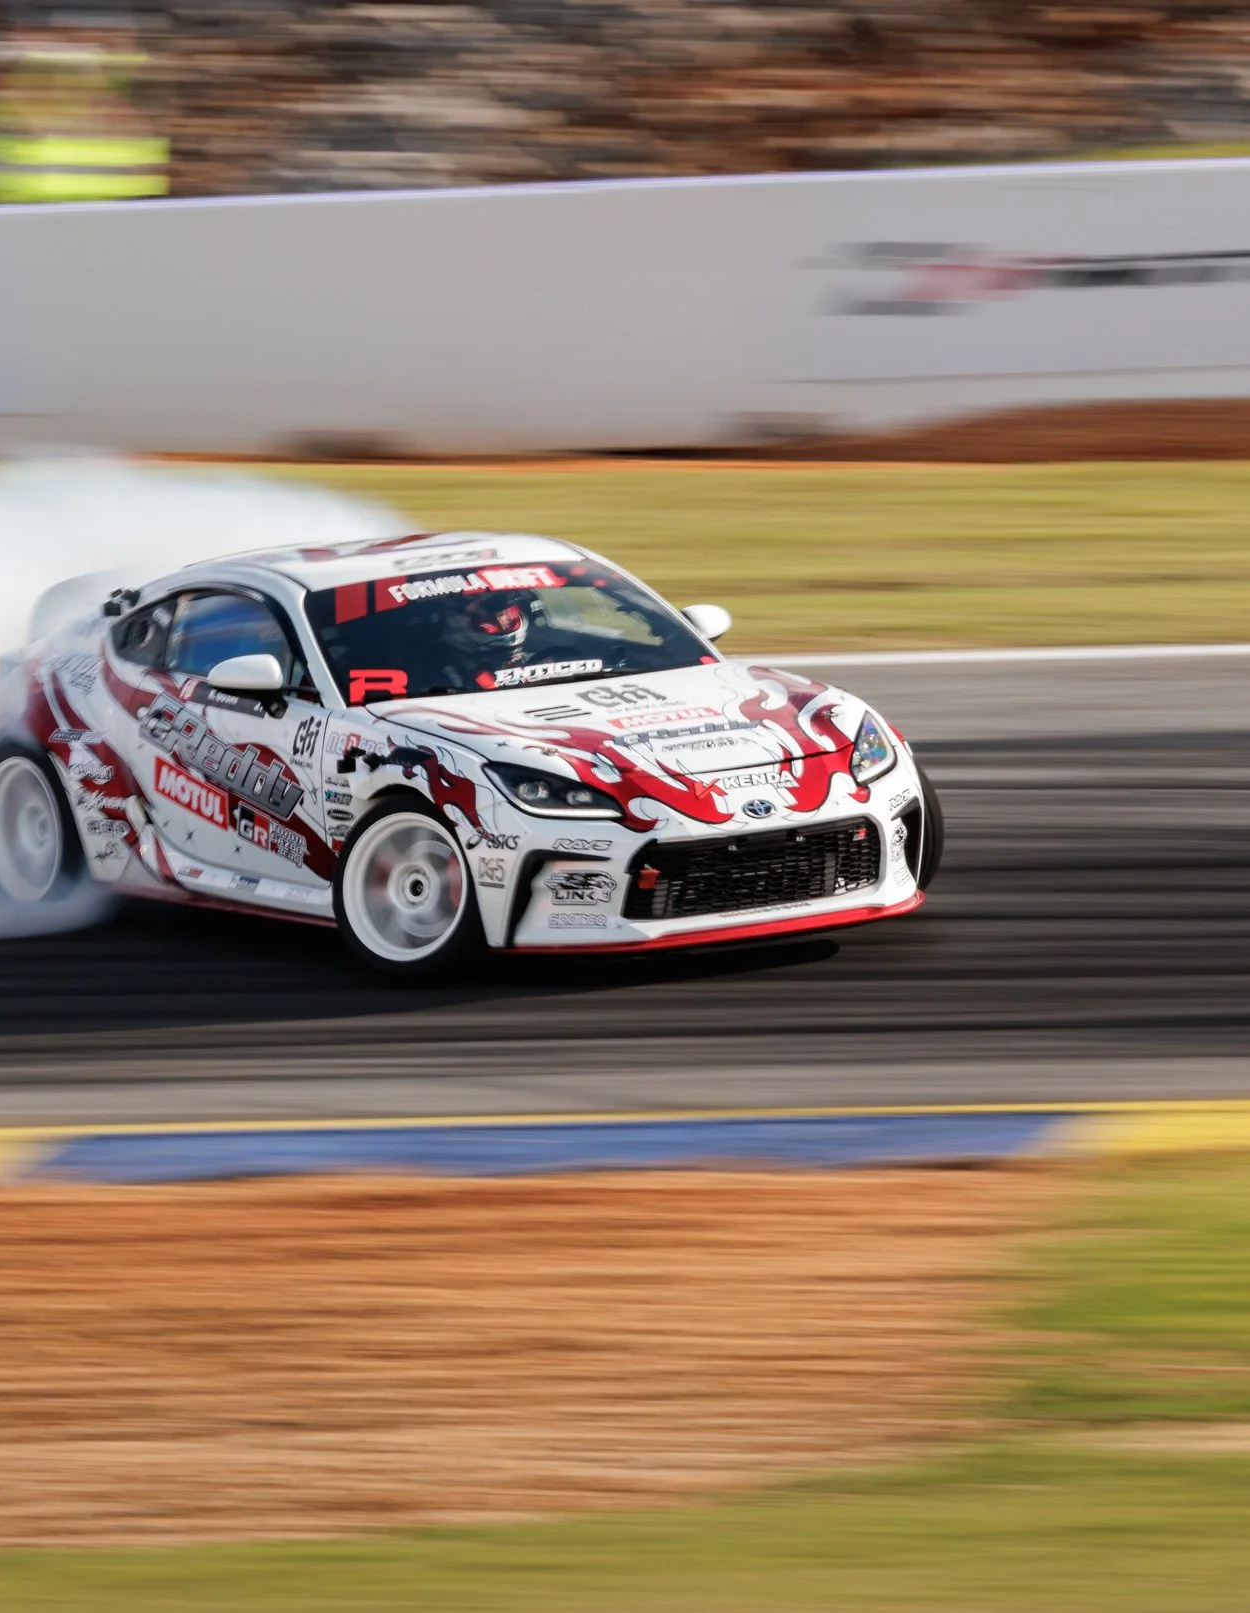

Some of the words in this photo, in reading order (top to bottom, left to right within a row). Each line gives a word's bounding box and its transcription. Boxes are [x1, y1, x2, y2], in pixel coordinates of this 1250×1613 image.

[387, 573, 489, 603] FORMULA
[620, 708, 713, 730] MOTUL
[723, 769, 795, 790] KENDA
[158, 764, 225, 825] MOTUL
[239, 818, 269, 849] GR
[552, 837, 614, 850] RAYS
[548, 913, 607, 929] sparco
